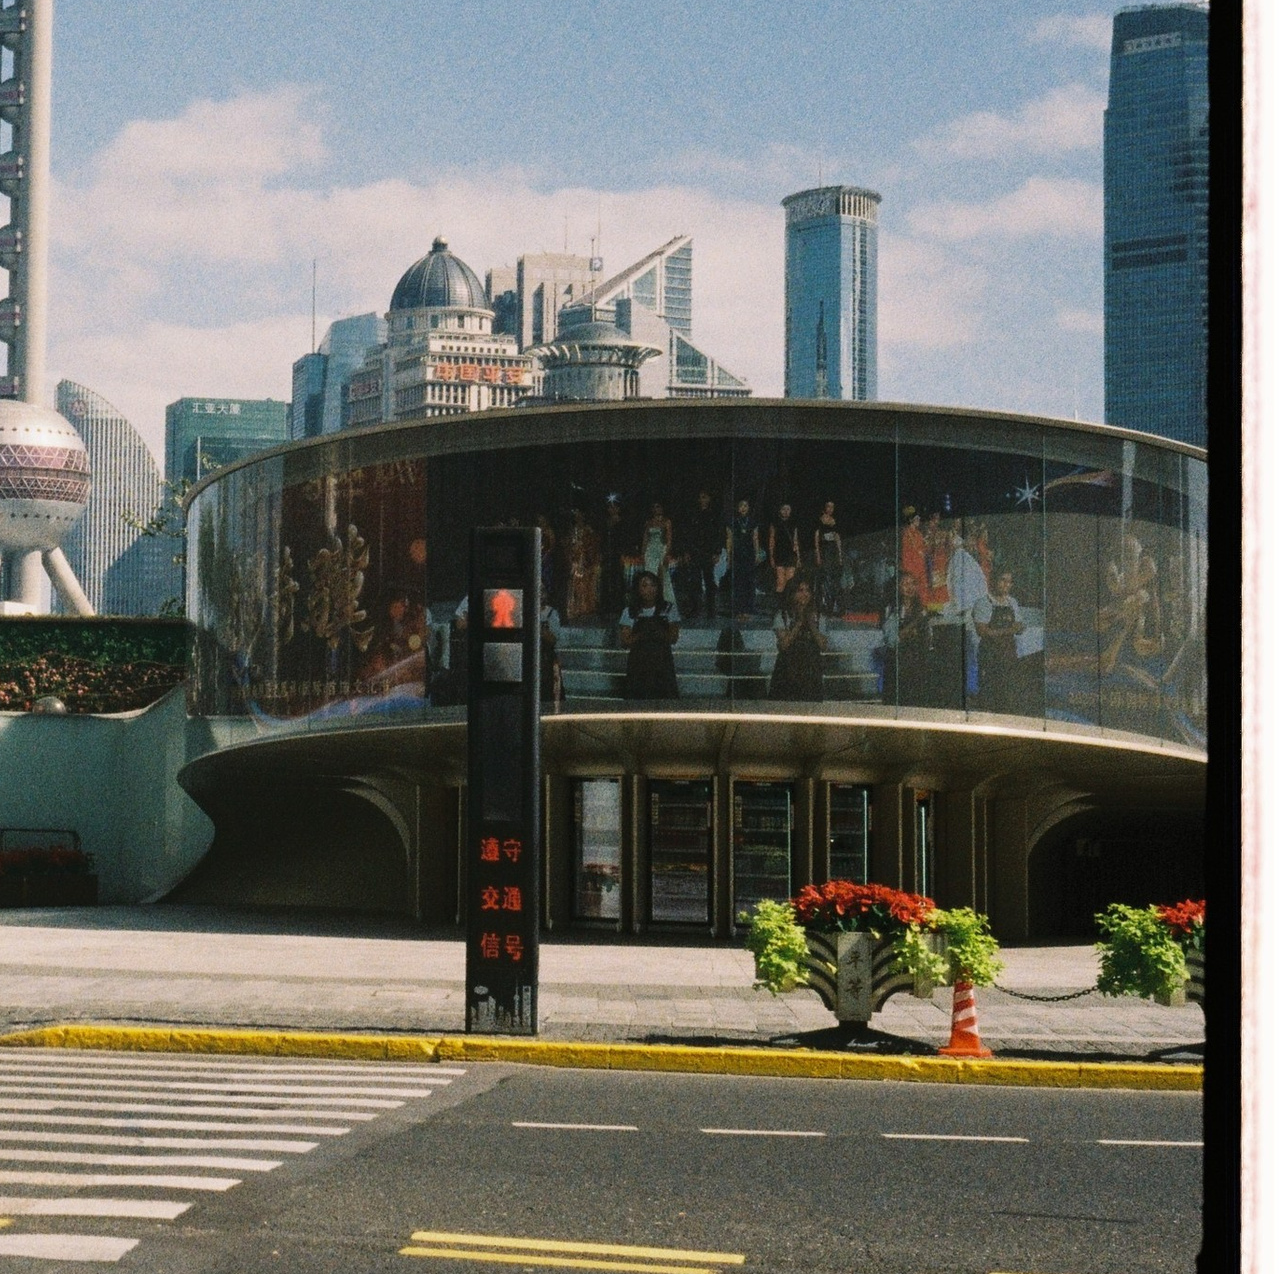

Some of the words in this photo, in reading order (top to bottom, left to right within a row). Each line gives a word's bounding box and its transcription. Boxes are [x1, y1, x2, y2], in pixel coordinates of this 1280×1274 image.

[436, 362, 524, 384] 中国平安
[480, 837, 522, 862] 遵守
[480, 885, 523, 912] 交通
[480, 932, 525, 961] 信号
